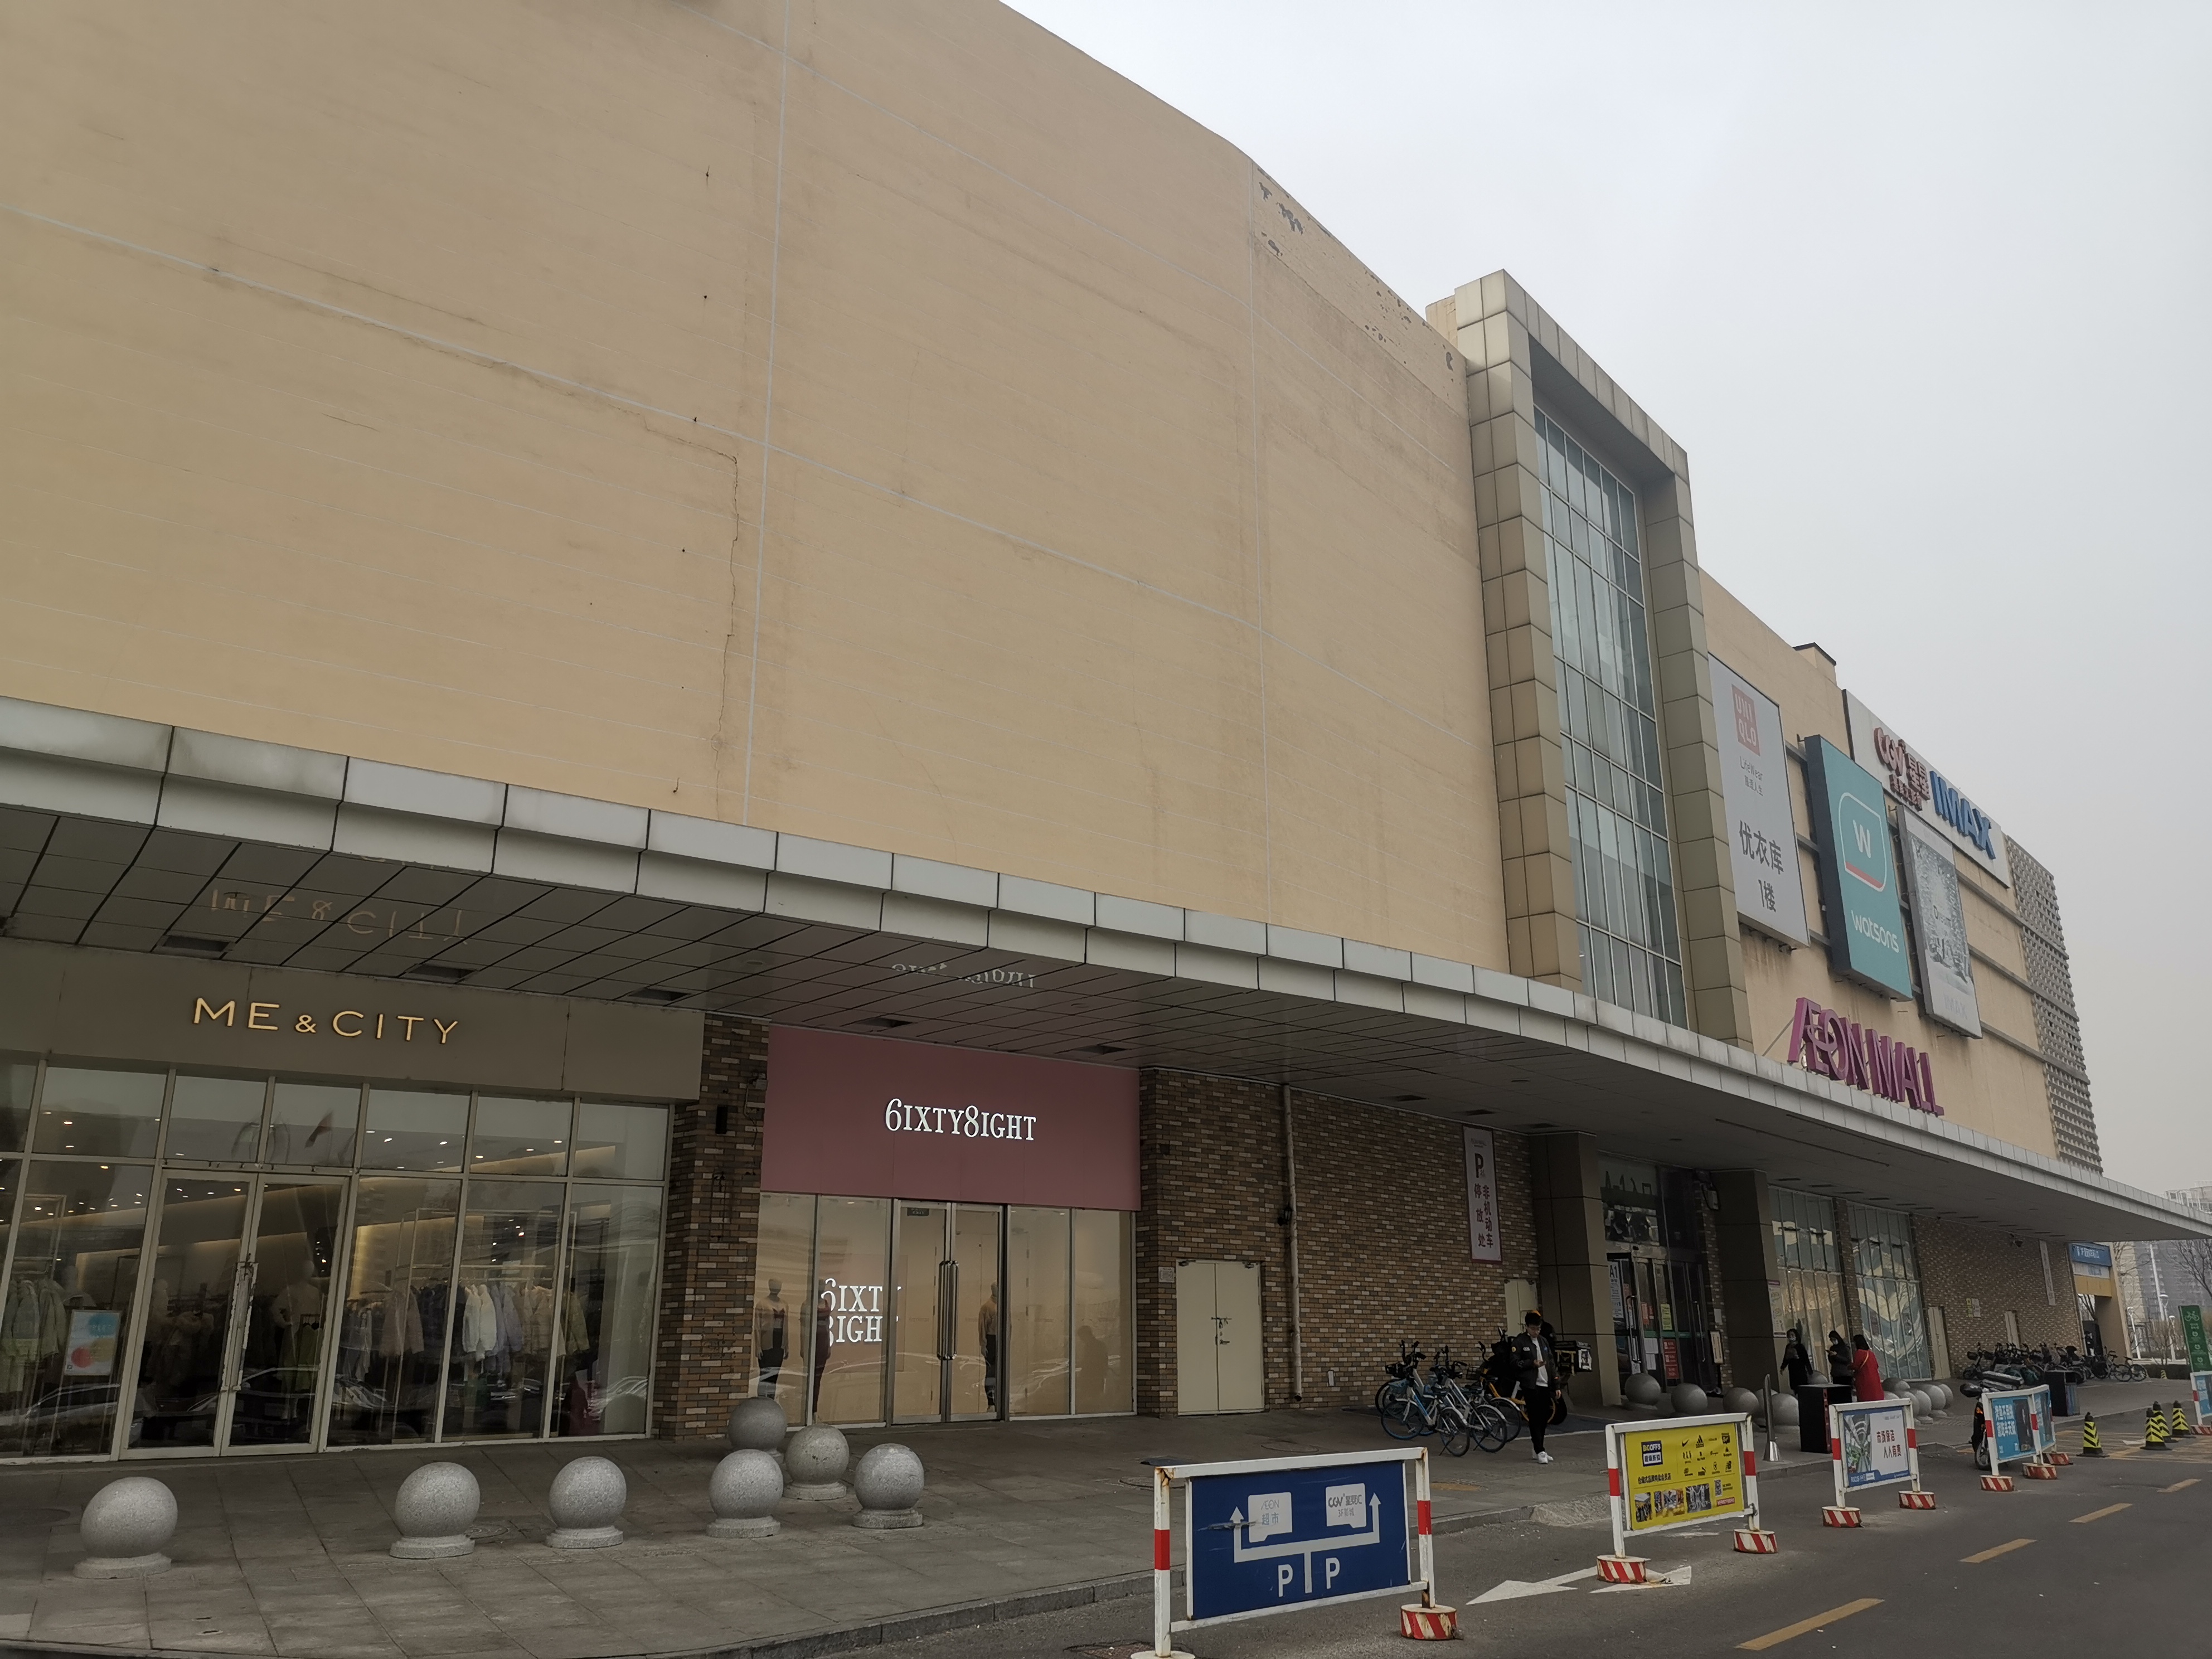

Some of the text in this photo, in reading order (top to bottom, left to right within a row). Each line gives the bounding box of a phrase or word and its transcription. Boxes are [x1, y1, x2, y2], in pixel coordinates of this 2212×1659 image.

[1734, 693, 1753, 722] UNI
[1738, 717, 1757, 747] QLO
[1739, 755, 1764, 781] LifeWear
[1874, 727, 1904, 777] CGV
[1929, 770, 1996, 860] IMAX
[1739, 819, 1784, 875] 优衣库
[1758, 879, 1777, 913] 1楼
[1850, 909, 1900, 953] watsons
[192, 997, 459, 1045] ME & CITY
[1865, 1029, 1944, 1117] MALL
[885, 1098, 1037, 1141] 6IXTY8IGHT
[1474, 1153, 1484, 1178] P
[1474, 1182, 1486, 1248] 停放处
[1482, 1184, 1494, 1249] 非机动车
[1884, 1444, 1901, 1459] 人人有责
[1262, 1512, 1279, 1526] 超市
[1328, 1496, 1343, 1508] CGV
[1278, 1564, 1293, 1598] P
[1326, 1557, 1340, 1589] P
